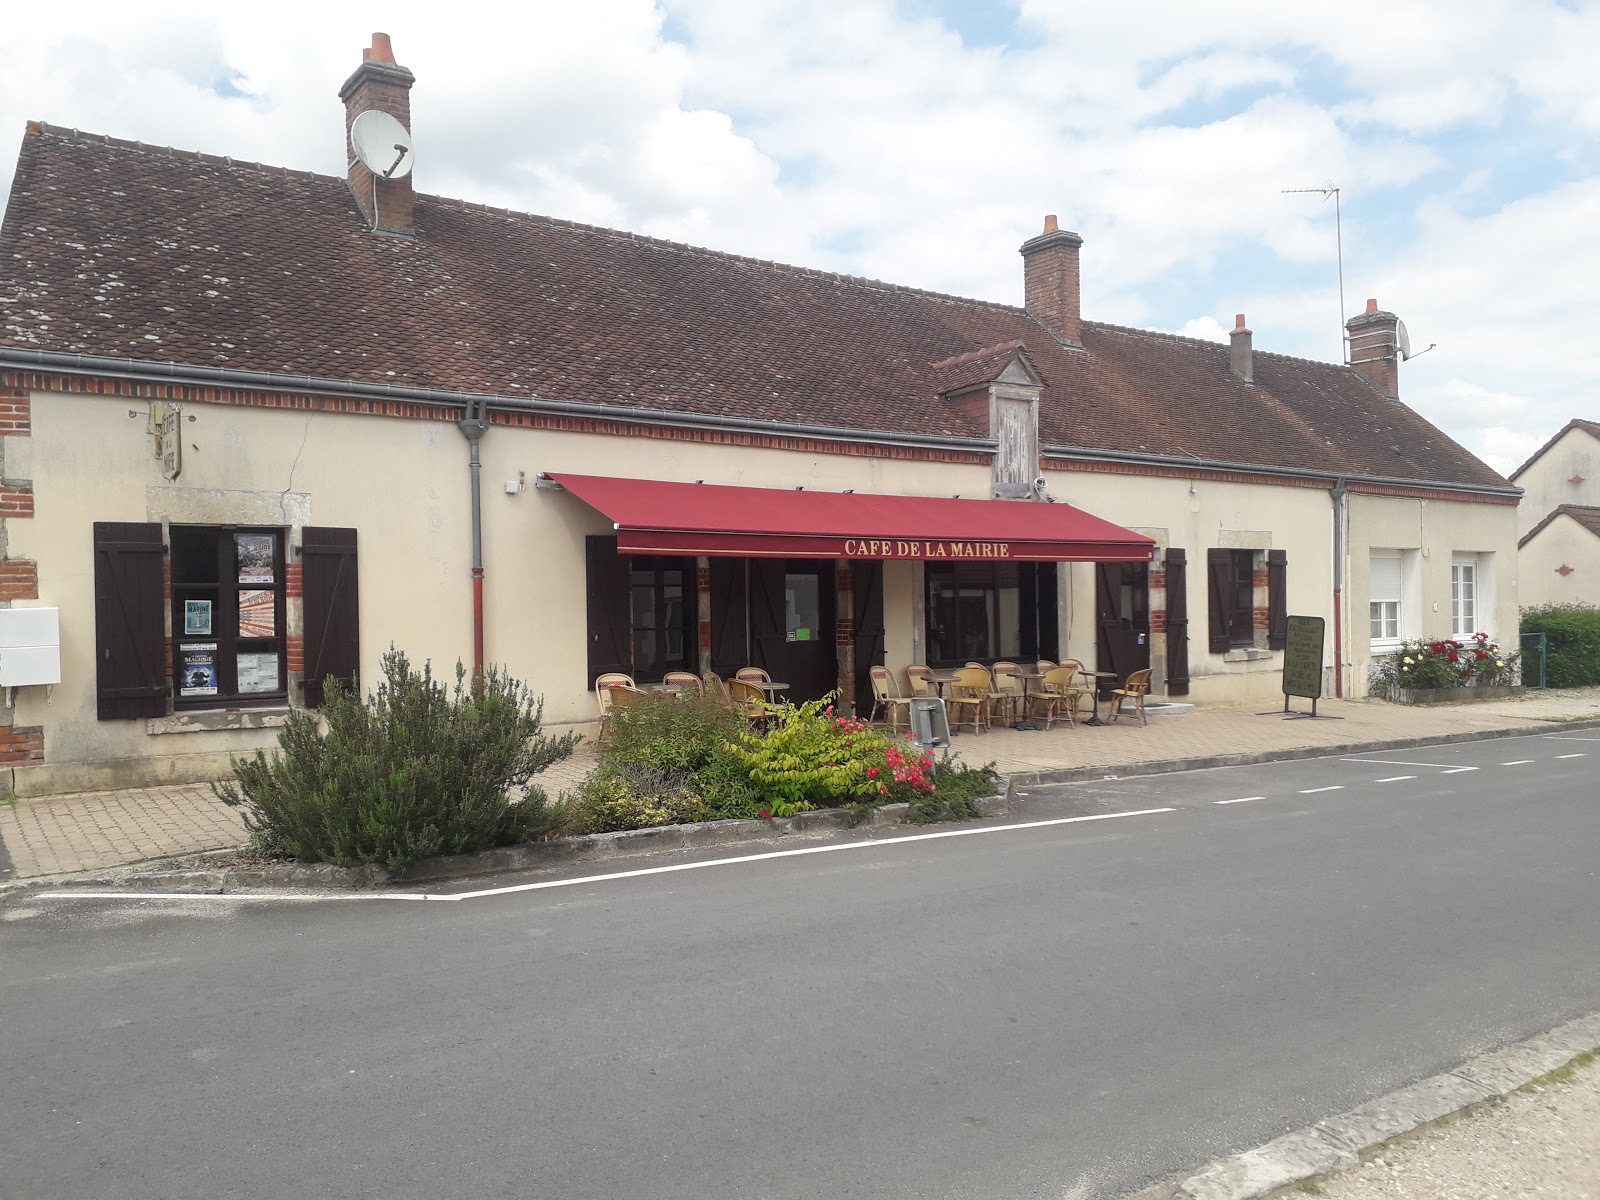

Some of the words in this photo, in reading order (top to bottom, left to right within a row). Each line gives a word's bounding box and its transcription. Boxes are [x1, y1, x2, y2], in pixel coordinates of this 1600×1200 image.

[844, 539, 892, 556] CAFE
[897, 541, 921, 557] DE
[925, 542, 947, 558] LA
[950, 542, 1009, 558] MAIRIE
